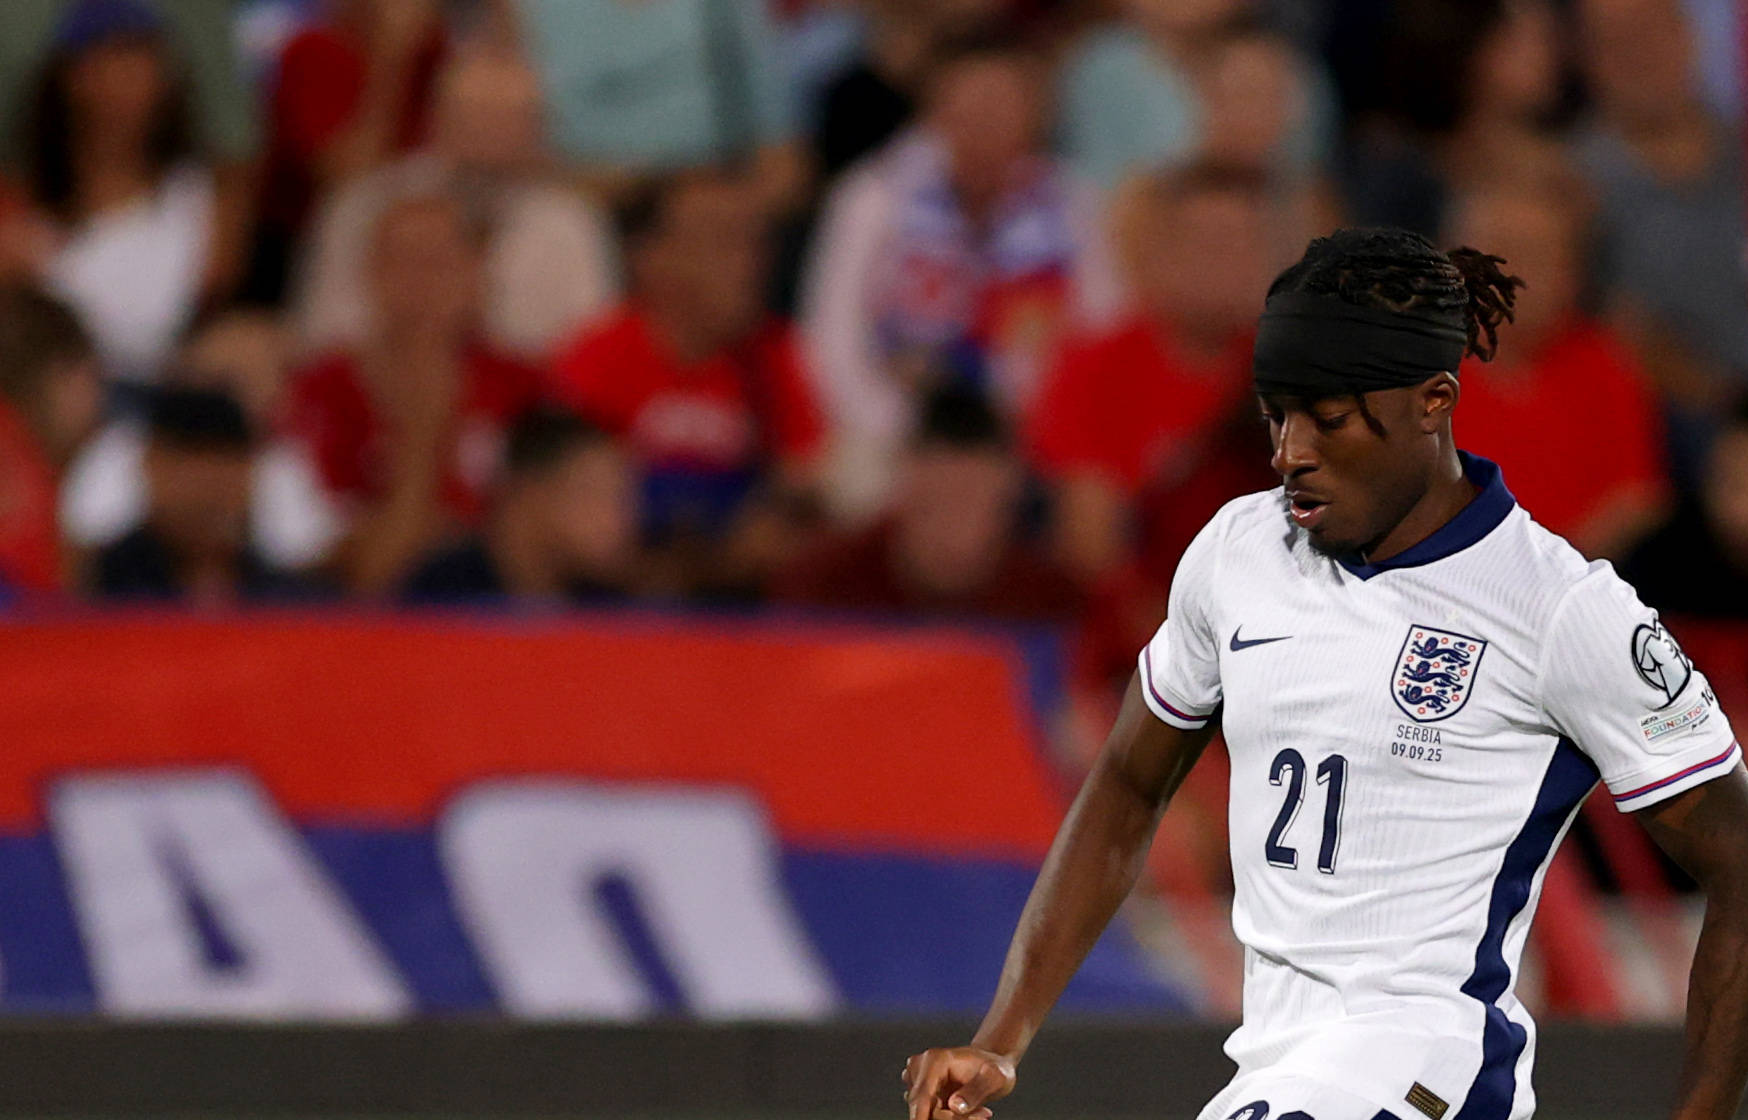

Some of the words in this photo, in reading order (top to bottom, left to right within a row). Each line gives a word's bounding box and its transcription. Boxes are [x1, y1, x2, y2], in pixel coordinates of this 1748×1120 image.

[1396, 724, 1441, 745] SERBIA
[1391, 741, 1442, 762] 09.09.25
[1265, 748, 1348, 874] 21
